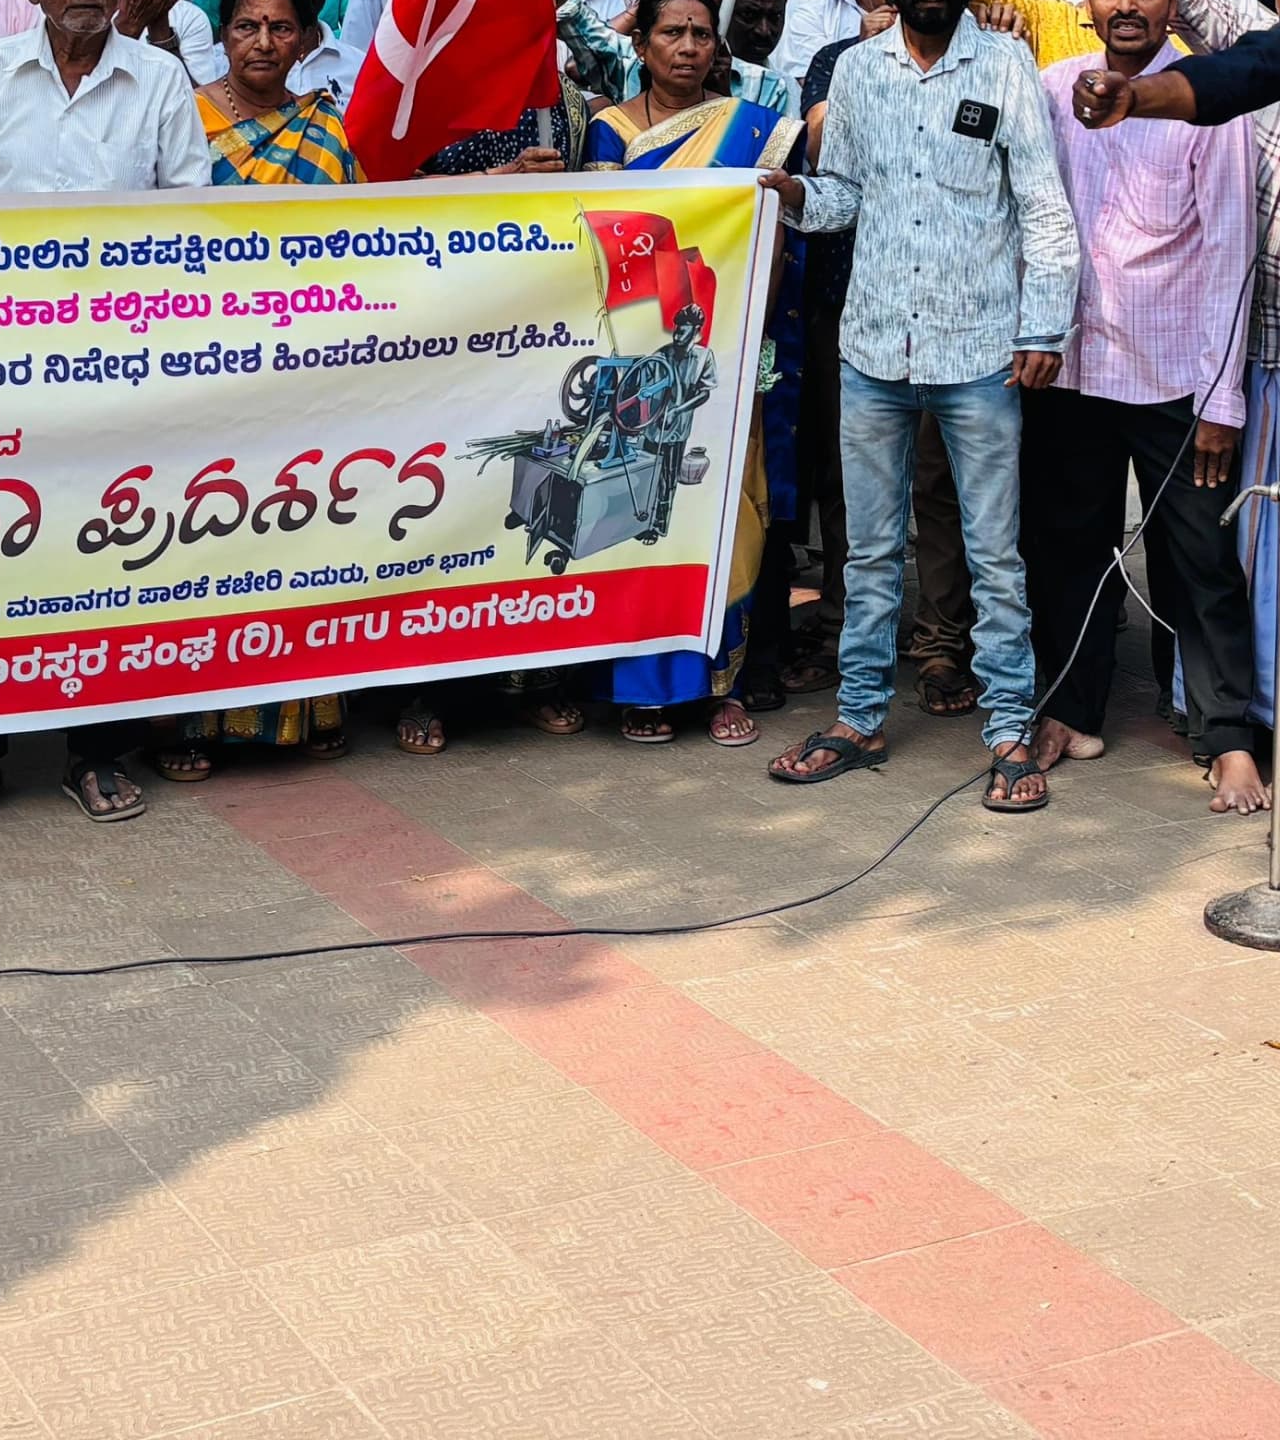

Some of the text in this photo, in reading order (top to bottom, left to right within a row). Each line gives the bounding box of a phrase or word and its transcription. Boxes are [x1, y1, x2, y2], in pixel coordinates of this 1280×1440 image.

[100, 231, 270, 274] ಏಕಪಕ್ಷೀಯ
[280, 226, 442, 268] ಧಾಳಿಯನ್ನು
[448, 222, 574, 254] ಖಂಡಿಸಿ...
[90, 288, 211, 334] ಕಲ್ಪಿಸಲು
[222, 283, 397, 327] ಒತ್ತಾಯಿಸಿ....
[43, 347, 149, 387] ನಿಷೇಧ
[160, 342, 262, 378] ಆದೇಶ
[272, 334, 458, 371] ಹಿಂಪಡೆಯಲು
[467, 322, 595, 358] ಆಗ್ರಹಿಸಿ...
[77, 442, 446, 571] ಪ್ರದರ್ಶನ
[6, 586, 131, 619] ಮಹಾನಗರ
[138, 576, 209, 606] ಪಾಲಿಕೆ
[215, 569, 282, 597] ಕಚೇರಿ
[289, 563, 369, 589] ಎದುರು,
[376, 554, 434, 579] ಲಾಲ್
[439, 545, 495, 573] ಭಾಗ್
[119, 628, 216, 672] ಸಂಘ
[227, 621, 293, 662] (ರಿ),
[305, 611, 390, 648] CITU
[400, 585, 595, 637] ಮಂಗಳೂರು
